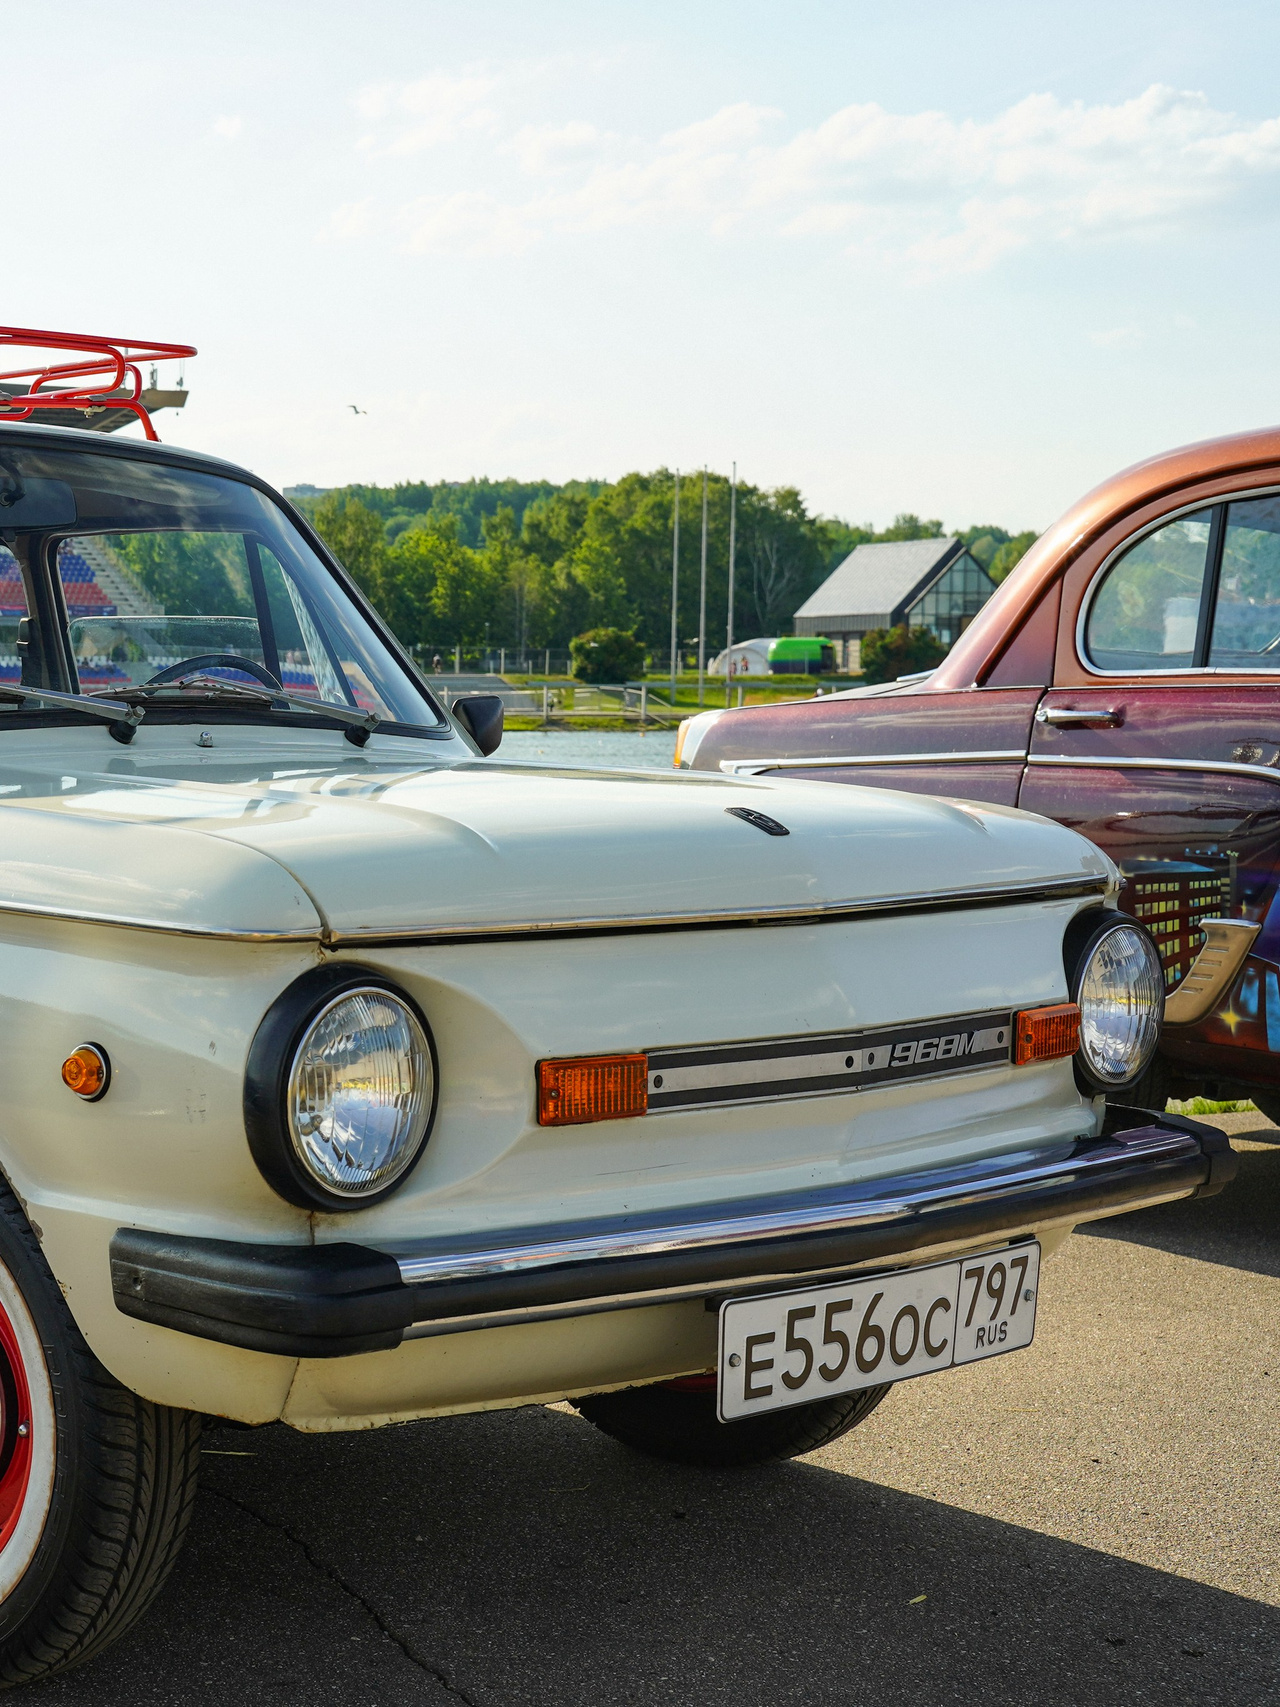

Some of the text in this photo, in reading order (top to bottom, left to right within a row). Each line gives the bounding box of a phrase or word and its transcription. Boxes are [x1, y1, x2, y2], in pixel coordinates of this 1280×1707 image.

[891, 1032, 978, 1067] 968M
[744, 1256, 1029, 1400] E556OC 797
[975, 1321, 1008, 1349] RUS
